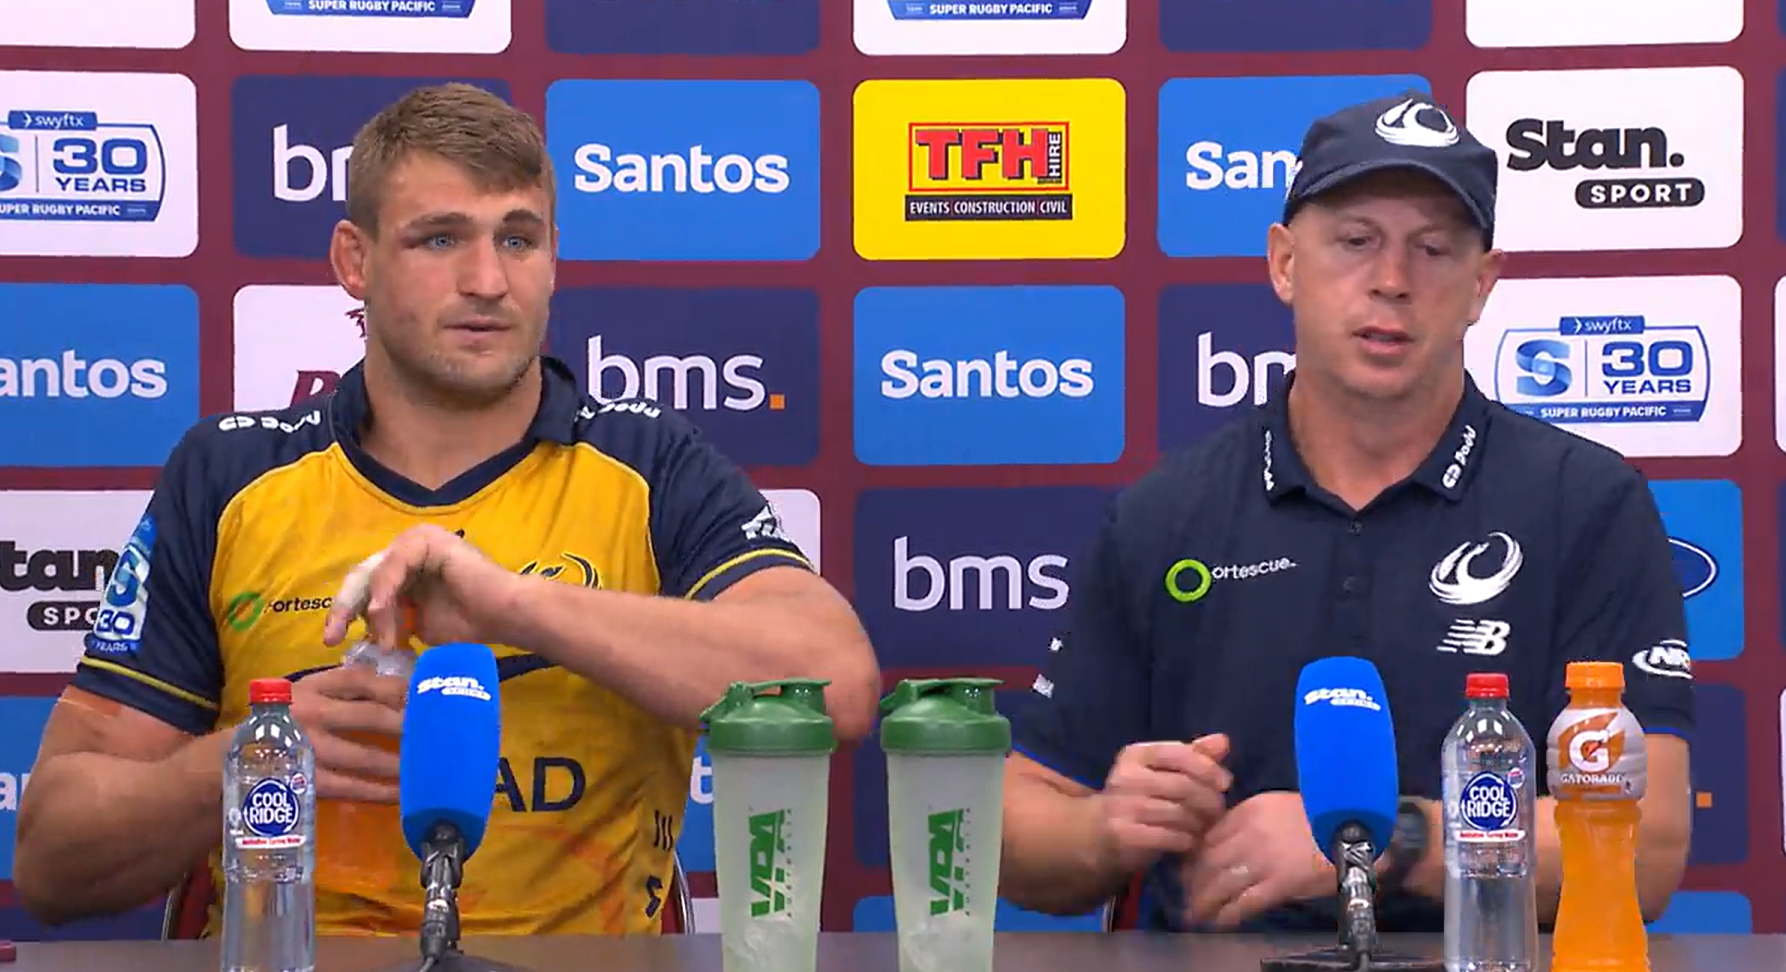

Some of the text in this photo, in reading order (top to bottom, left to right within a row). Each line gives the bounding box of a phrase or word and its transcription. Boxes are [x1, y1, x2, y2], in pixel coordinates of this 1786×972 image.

[308, 0, 347, 10] SUPER
[349, 0, 389, 11] RUGBY
[391, 1, 436, 12] PACIFIC
[929, 3, 967, 14] SUPER
[969, 3, 1008, 14] RUGBY
[1009, 3, 1053, 14] PACIFIC
[35, 113, 84, 129] swyftx
[915, 129, 1048, 179] TFH
[1505, 118, 1685, 171] Stan.
[52, 138, 148, 175] 30
[1048, 132, 1061, 177] HIRE
[574, 143, 790, 194] Santos
[1186, 140, 1301, 190] San
[55, 177, 147, 192] YEARS
[1590, 183, 1692, 203] SPORT
[0, 203, 30, 214] UPER
[33, 204, 75, 215] RUGBY
[76, 204, 121, 215] PACIFIC
[909, 200, 1068, 214] EVENTS CONSTRUCTION CIVIL
[1584, 317, 1632, 334] swyftx
[1601, 340, 1694, 377] 30
[0, 349, 168, 398] antos
[881, 349, 1094, 398] Santos
[1603, 379, 1692, 394] YEARS
[1540, 407, 1578, 418] SUPER
[1580, 407, 1620, 418] RUGBY
[1622, 405, 1667, 417] PACIFIC
[0, 541, 119, 591] tan
[1211, 557, 1290, 579] ortescue
[43, 606, 99, 625] SPO
[252, 791, 291, 808] COOL
[1469, 785, 1509, 801] COOL
[249, 806, 294, 825] RIDGE
[1466, 800, 1512, 818] RIDGE
